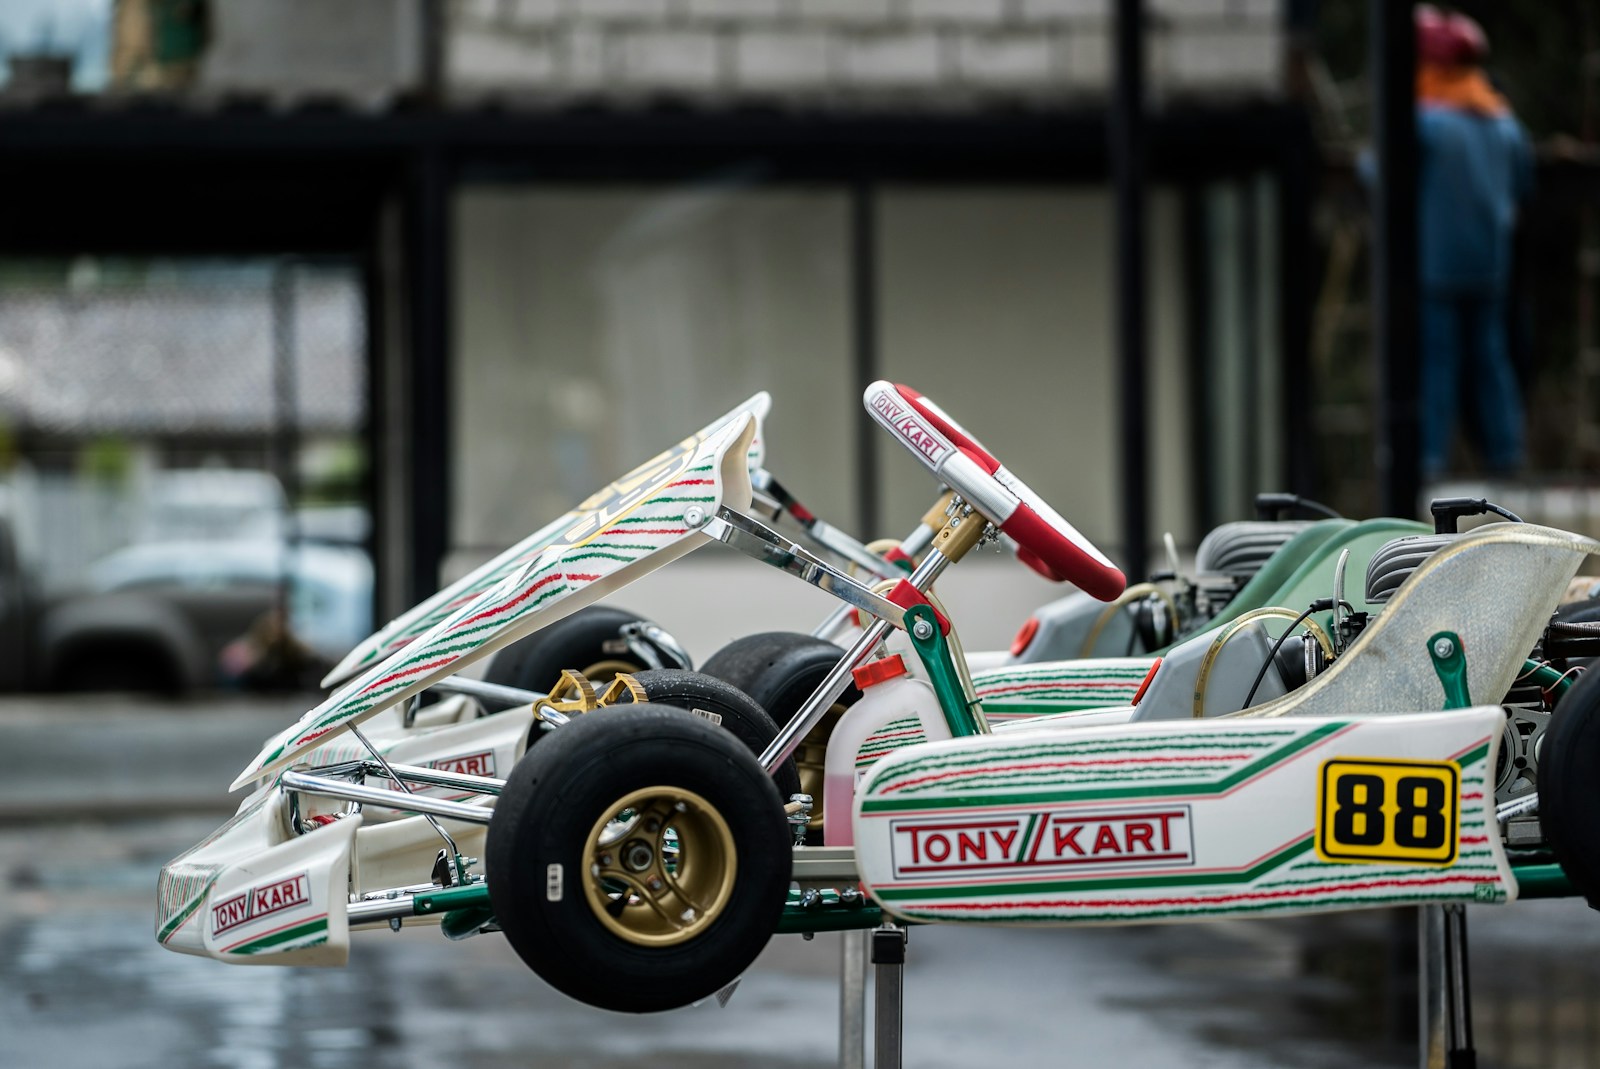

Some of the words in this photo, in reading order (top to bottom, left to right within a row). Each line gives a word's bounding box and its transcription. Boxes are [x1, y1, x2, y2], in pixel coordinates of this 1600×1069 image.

[902, 418, 946, 457] KART
[896, 820, 1019, 864] TONY
[1052, 811, 1185, 857] KART
[1333, 773, 1446, 849] 88
[212, 894, 247, 929] TONY
[256, 873, 306, 911] KART
